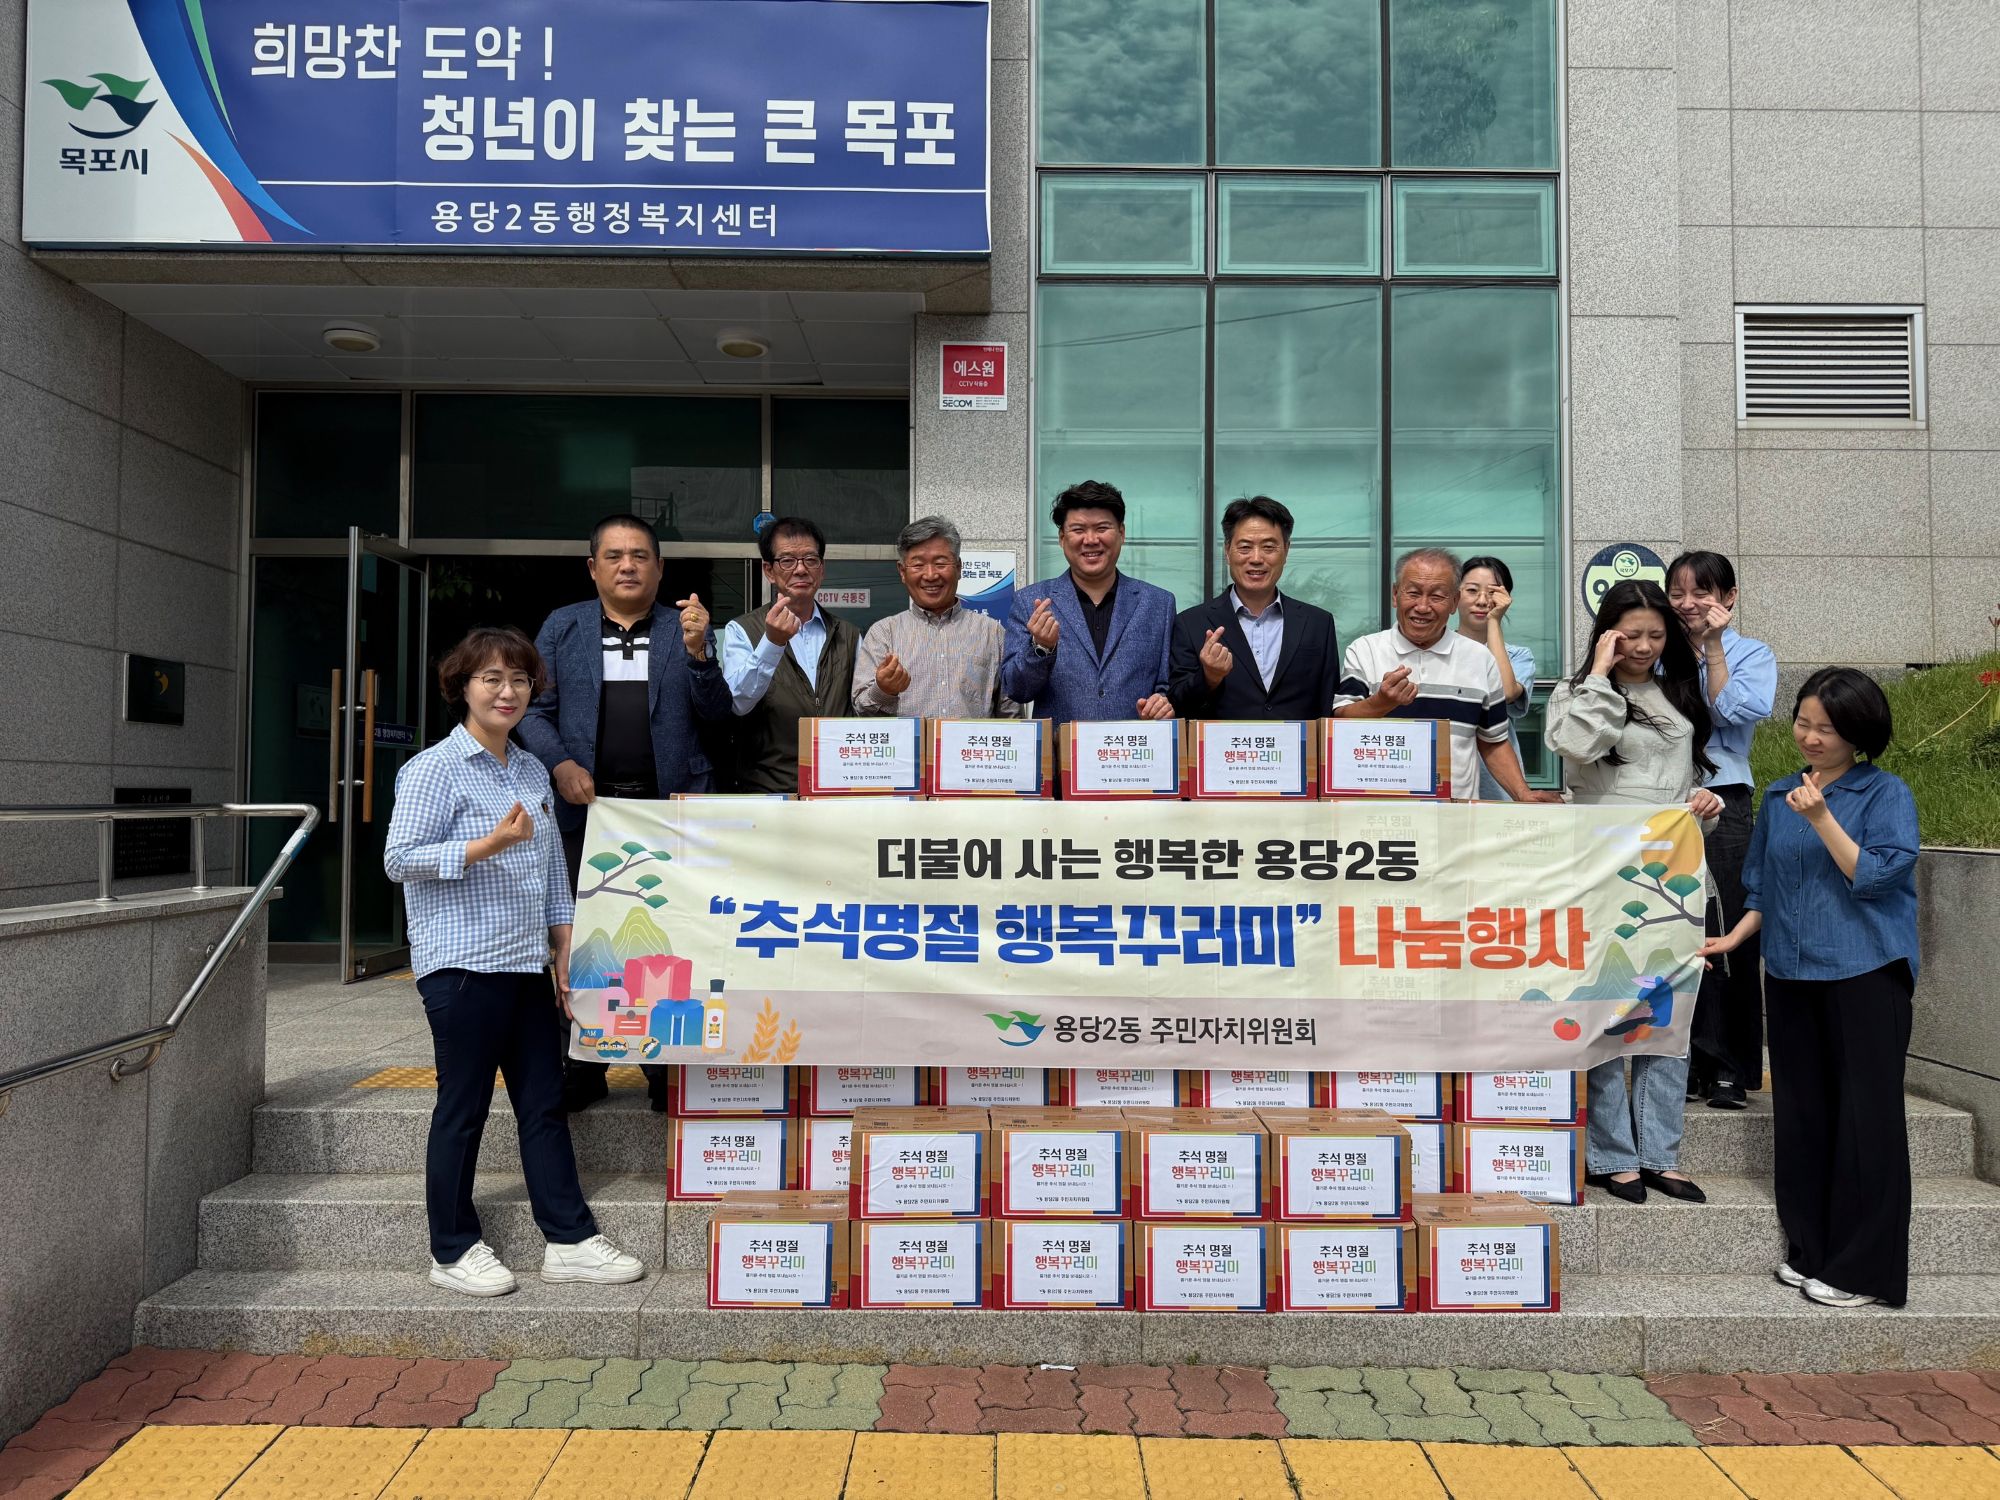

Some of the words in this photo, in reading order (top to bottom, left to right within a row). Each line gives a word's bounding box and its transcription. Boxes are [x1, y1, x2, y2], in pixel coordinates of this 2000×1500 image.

[251, 24, 400, 80] 희망찬
[422, 25, 522, 81] 도약
[543, 26, 553, 81] !
[422, 95, 595, 163] 청년이
[623, 97, 736, 164] 찾는
[764, 100, 816, 165] 큰
[844, 101, 956, 167] 목포
[59, 147, 149, 176] 목포시
[431, 199, 779, 238] 용당2동행정복지센터
[953, 360, 994, 377] 에스원
[942, 399, 972, 408] SECOM
[988, 570, 1002, 578] 목포
[817, 592, 839, 603] CCTV
[846, 733, 865, 744] 추석
[869, 733, 889, 744] 명절
[968, 736, 987, 747] 추석
[991, 736, 1011, 747] 명절
[1104, 735, 1123, 746] 추석
[1128, 735, 1147, 746] 명절
[1231, 737, 1251, 748] 추석
[1255, 737, 1275, 748] 명절
[1360, 735, 1380, 746] 추석
[1385, 735, 1405, 746] 명절
[839, 746, 895, 758] 행복꾸러미
[961, 749, 1017, 761] 행복꾸러미
[1098, 749, 1153, 761] 행복꾸러미
[1225, 751, 1281, 763] 행복꾸러미
[1353, 748, 1412, 761] 행복꾸러미
[877, 837, 1002, 881] 더불어
[1014, 838, 1101, 881] 사는
[1114, 838, 1244, 882] 행복한
[1254, 838, 1420, 883] 용당2동
[1338, 906, 1591, 971] 나눔행사
[1052, 1014, 1142, 1044] 용당2동
[1150, 1015, 1318, 1047] 주민자치위원회
[707, 1067, 764, 1080] 행복꾸러미
[838, 1068, 895, 1080] 행복꾸러미
[967, 1068, 1024, 1079] 행복꾸러미
[1097, 1070, 1154, 1083] 행복꾸러미
[1231, 1072, 1289, 1084] 행복꾸러미
[1358, 1073, 1416, 1085] 행복꾸러미
[1493, 1075, 1551, 1088] 행복꾸러미
[710, 1136, 730, 1147] 추석
[734, 1136, 754, 1147] 명절
[703, 1150, 761, 1163] 행복꾸러미
[899, 1150, 921, 1163] 추석
[925, 1150, 947, 1163] 명절
[1039, 1148, 1061, 1161] 추석
[1066, 1148, 1087, 1161] 명절
[1179, 1151, 1201, 1163] 추석
[1205, 1151, 1227, 1163] 명절
[1499, 1145, 1519, 1157] 추석
[1524, 1145, 1544, 1157] 명절
[1319, 1153, 1340, 1165] 추석
[1345, 1153, 1366, 1165] 명절
[1492, 1159, 1551, 1172] 행복꾸러미
[892, 1165, 954, 1180] 행복꾸러미
[1032, 1164, 1094, 1177] 행복꾸러미
[1172, 1166, 1234, 1180] 행복꾸러미
[1311, 1168, 1373, 1182] 행복꾸러미
[749, 1240, 771, 1252] 추석
[776, 1240, 798, 1252] 명절
[899, 1240, 921, 1253] 추석
[926, 1240, 947, 1253] 명절
[1042, 1240, 1064, 1253] 추석
[1069, 1240, 1090, 1253] 명절
[1184, 1244, 1205, 1257] 추석
[1210, 1244, 1232, 1257] 명절
[1320, 1245, 1342, 1258] 추석
[1347, 1245, 1369, 1258] 명절
[1468, 1243, 1490, 1255] 추석
[1494, 1243, 1516, 1255] 명절
[742, 1255, 805, 1269] 행복꾸러미
[892, 1256, 954, 1269] 행복꾸러미
[1035, 1256, 1097, 1269] 행복꾸러미
[1176, 1260, 1239, 1273] 행복꾸러미
[1313, 1260, 1376, 1274] 행복꾸러미
[1461, 1258, 1523, 1272] 행복꾸러미
